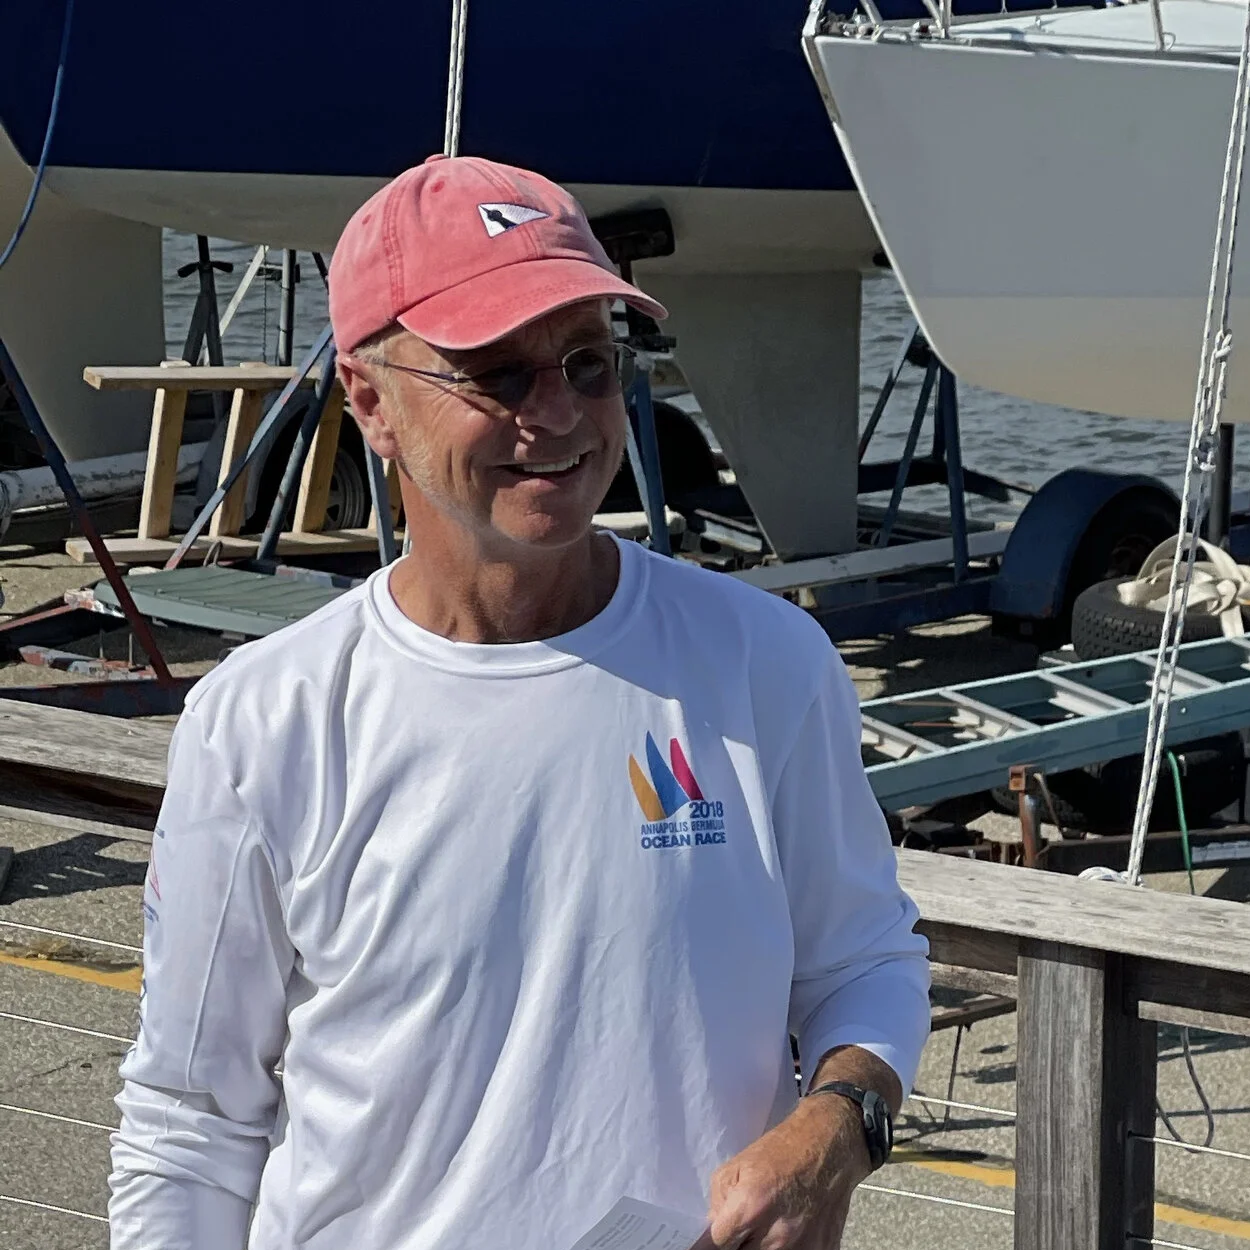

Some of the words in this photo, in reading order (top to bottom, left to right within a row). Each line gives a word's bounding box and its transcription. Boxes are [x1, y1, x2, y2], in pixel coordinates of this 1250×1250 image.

[689, 801, 724, 819] 2018
[641, 821, 688, 835] ANNAPOLIS
[691, 819, 725, 832] BERMUDA
[641, 834, 691, 850] OCEAN
[695, 832, 727, 846] RACE
